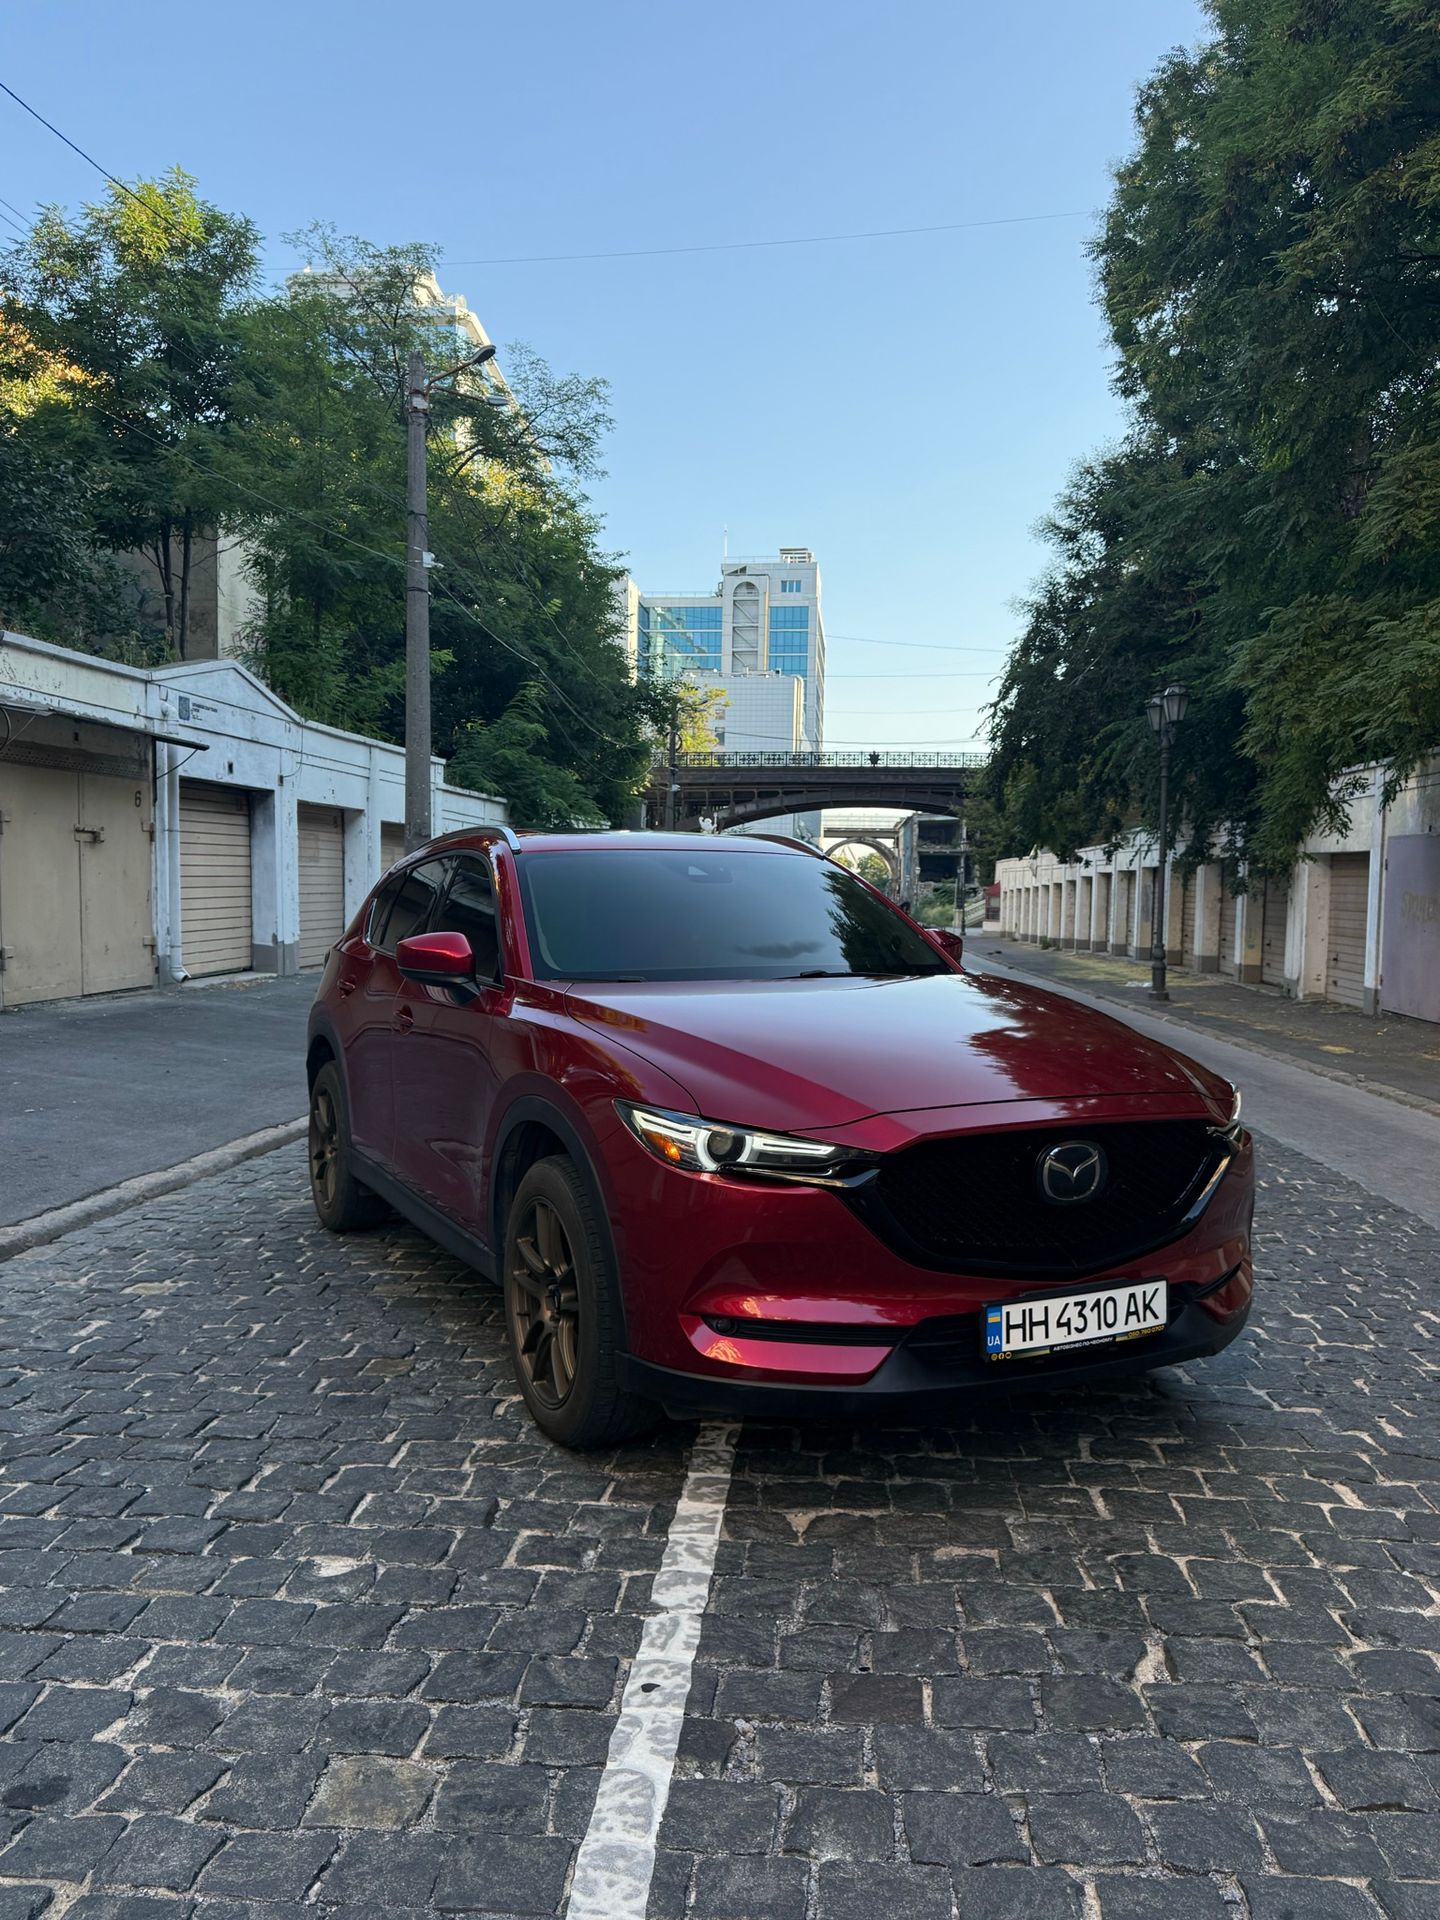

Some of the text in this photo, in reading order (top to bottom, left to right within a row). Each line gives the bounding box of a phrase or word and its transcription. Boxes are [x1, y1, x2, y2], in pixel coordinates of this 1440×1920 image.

[134, 790, 142, 808] 6
[1005, 1288, 1160, 1344] HH 4310 AK
[987, 1335, 1001, 1346] UA
